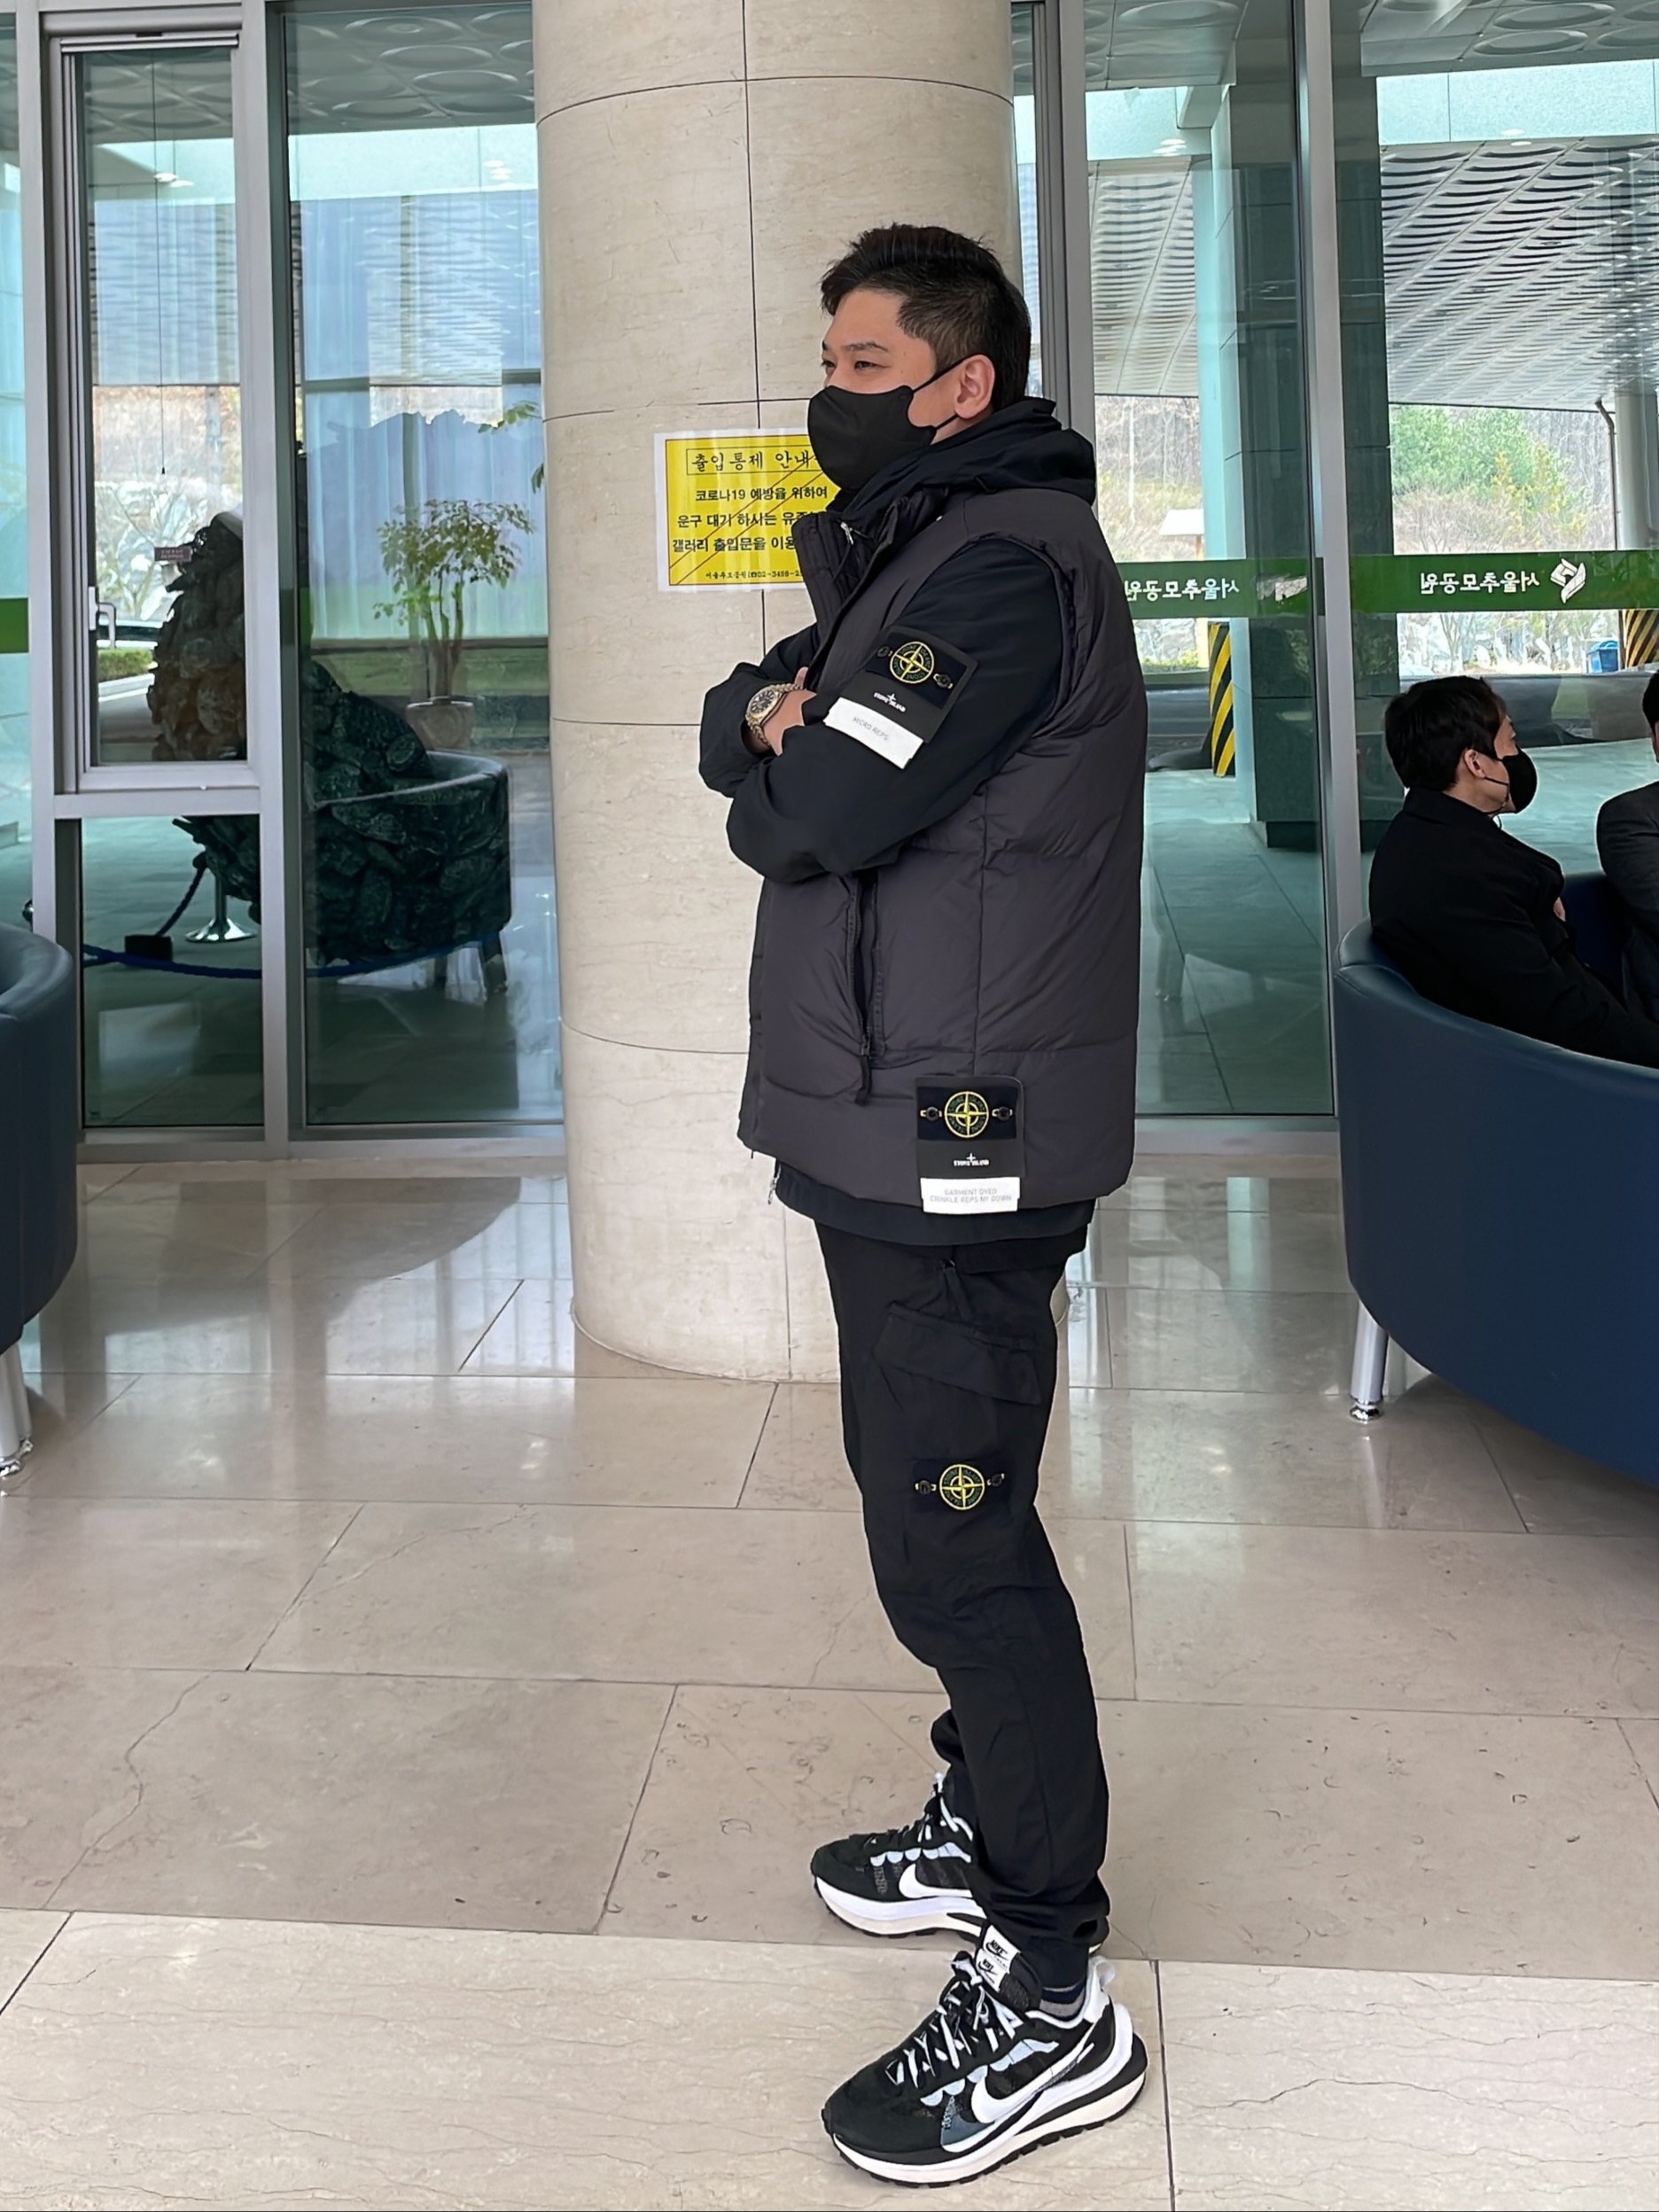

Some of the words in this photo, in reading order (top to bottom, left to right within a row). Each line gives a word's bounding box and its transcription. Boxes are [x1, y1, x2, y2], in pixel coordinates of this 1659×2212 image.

[691, 451, 763, 472] 출입통제
[696, 488, 746, 502] 코로나19
[751, 487, 786, 501] 예방을
[791, 486, 828, 500] 위하여
[677, 515, 702, 528] 운구
[707, 513, 732, 527] 대기
[737, 513, 777, 527] 하시는
[673, 538, 708, 552] 갤러리
[714, 537, 767, 552] 출입문을
[853, 716, 872, 730] MICRO
[872, 727, 889, 740] REPS
